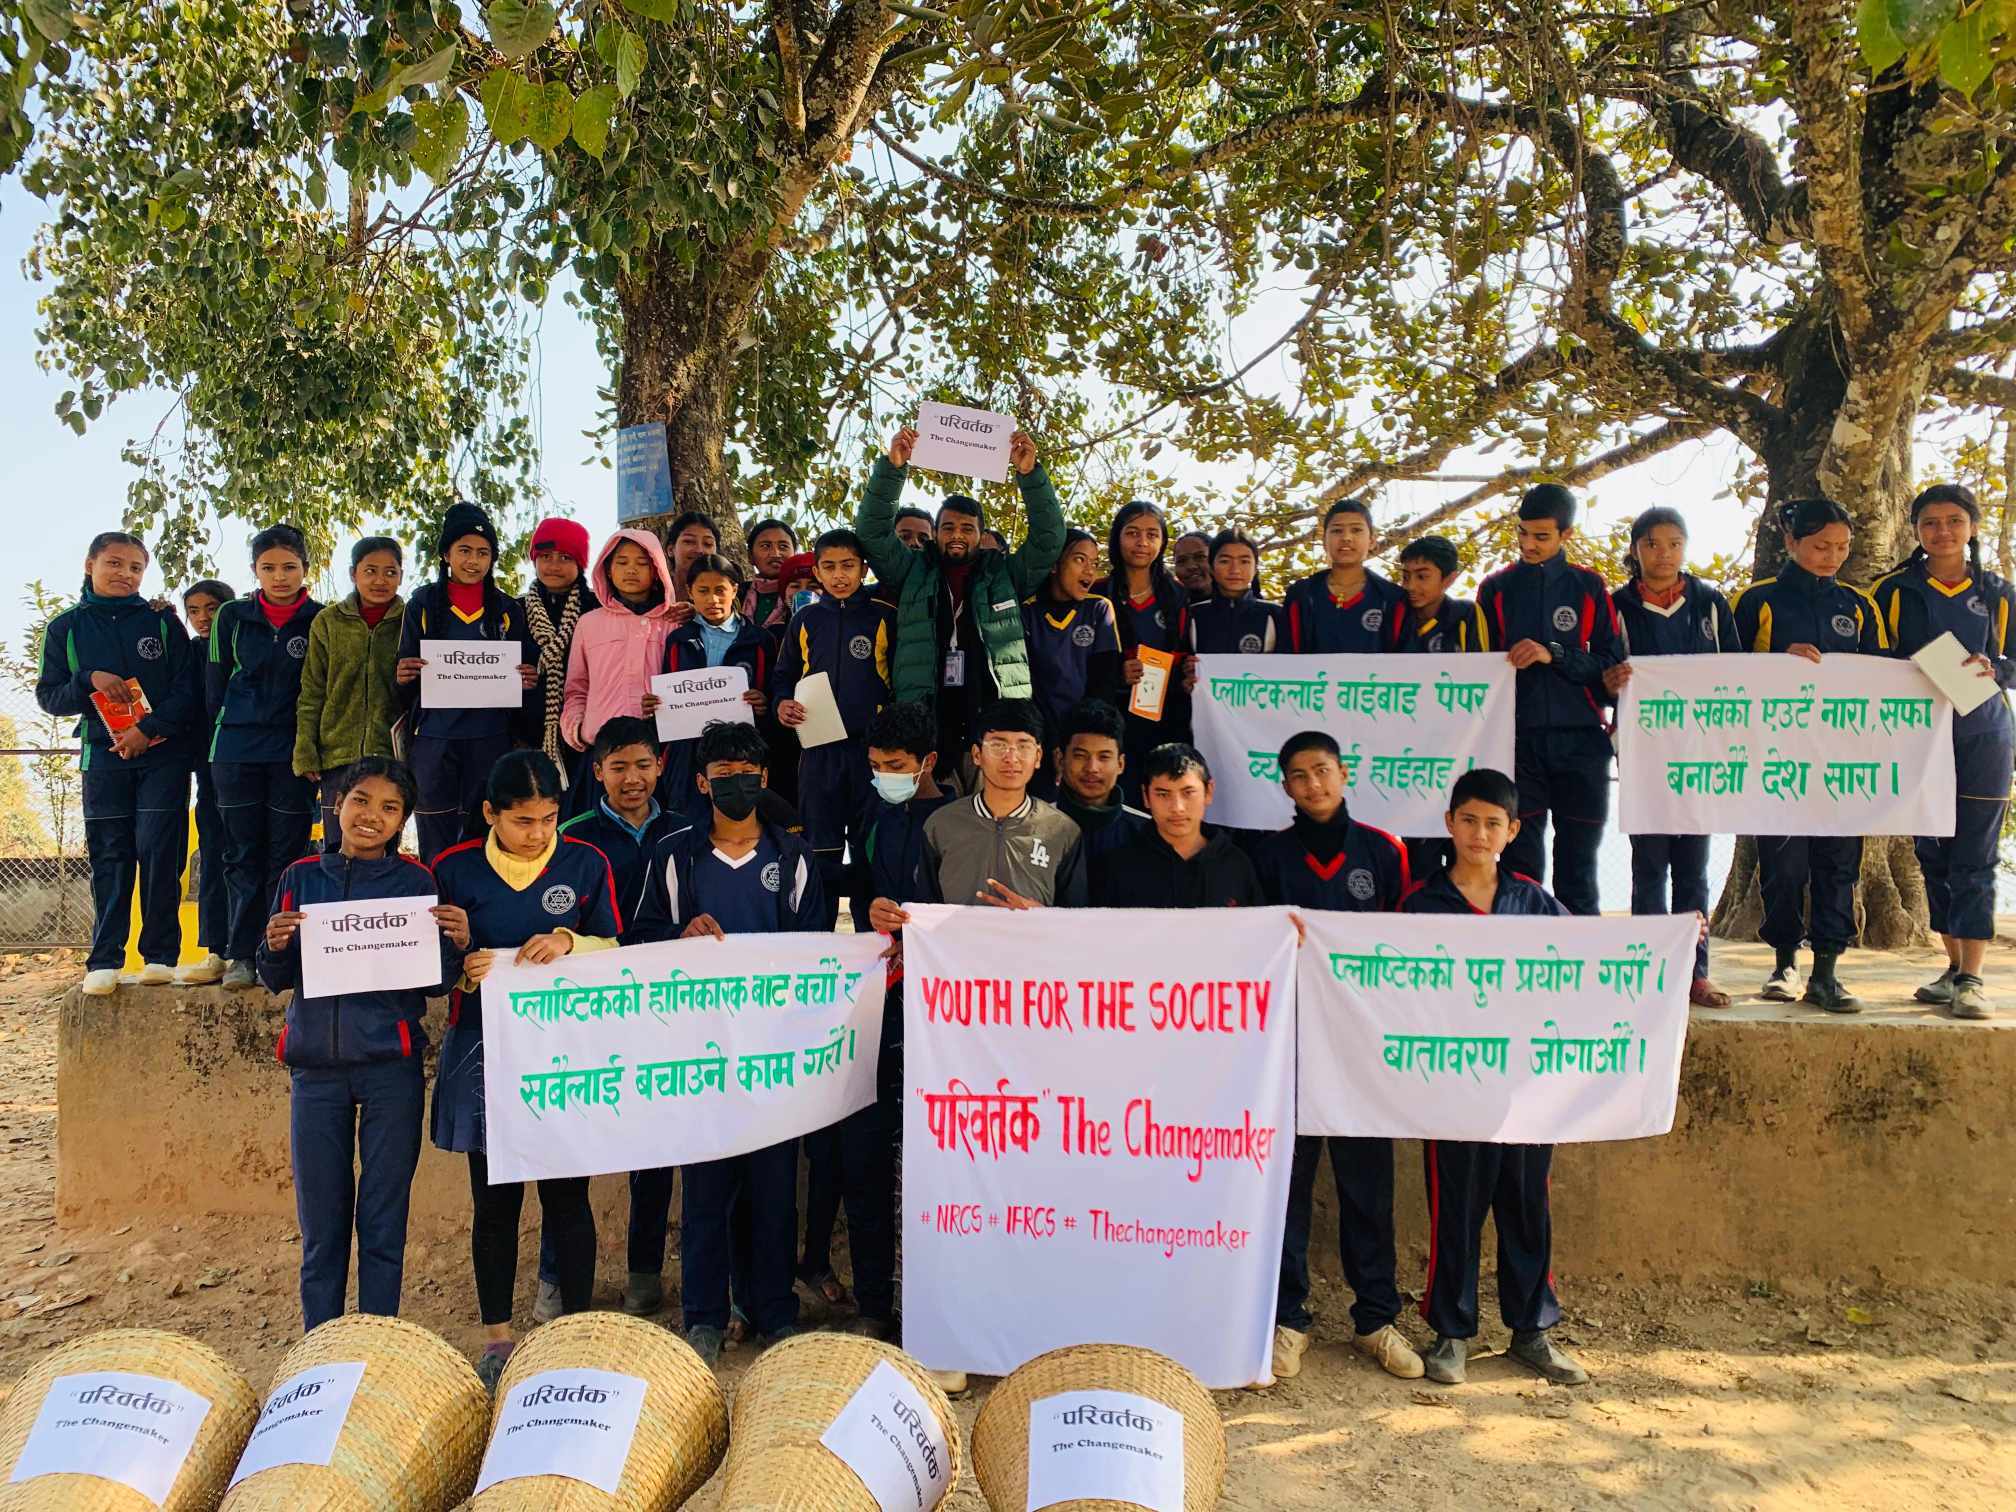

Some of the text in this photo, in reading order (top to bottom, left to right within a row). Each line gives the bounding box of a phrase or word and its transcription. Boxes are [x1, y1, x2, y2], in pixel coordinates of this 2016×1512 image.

[929, 433, 997, 452] The Changemaker
[453, 673, 507, 681] Changemaker
[685, 697, 737, 709] Changemaker
[1434, 671, 1491, 720] पेपर
[1638, 689, 1689, 736] हामि
[1760, 683, 1816, 733] एउटै
[1879, 697, 1935, 737] सफा
[1760, 746, 1814, 802] देश
[1029, 837, 1051, 869] LA
[323, 940, 419, 954] The Changemaker
[1464, 955, 1507, 1009] पुन
[1514, 944, 1586, 993] प्रयोग
[647, 968, 748, 1028] हानिकारक
[752, 973, 792, 1009] बाट
[843, 971, 863, 1005] र
[921, 976, 1272, 1034] YOUTH FOR THE SOCIETY
[635, 1040, 729, 1102] बचाउने
[736, 1050, 796, 1093] काम
[1056, 1094, 1113, 1158] The
[1123, 1096, 1278, 1184] Changemaker
[55, 1415, 170, 1446] The Changemaker
[506, 1417, 612, 1436] The Changemaker
[870, 1413, 889, 1436] The
[1051, 1438, 1164, 1461] The Changemaker
